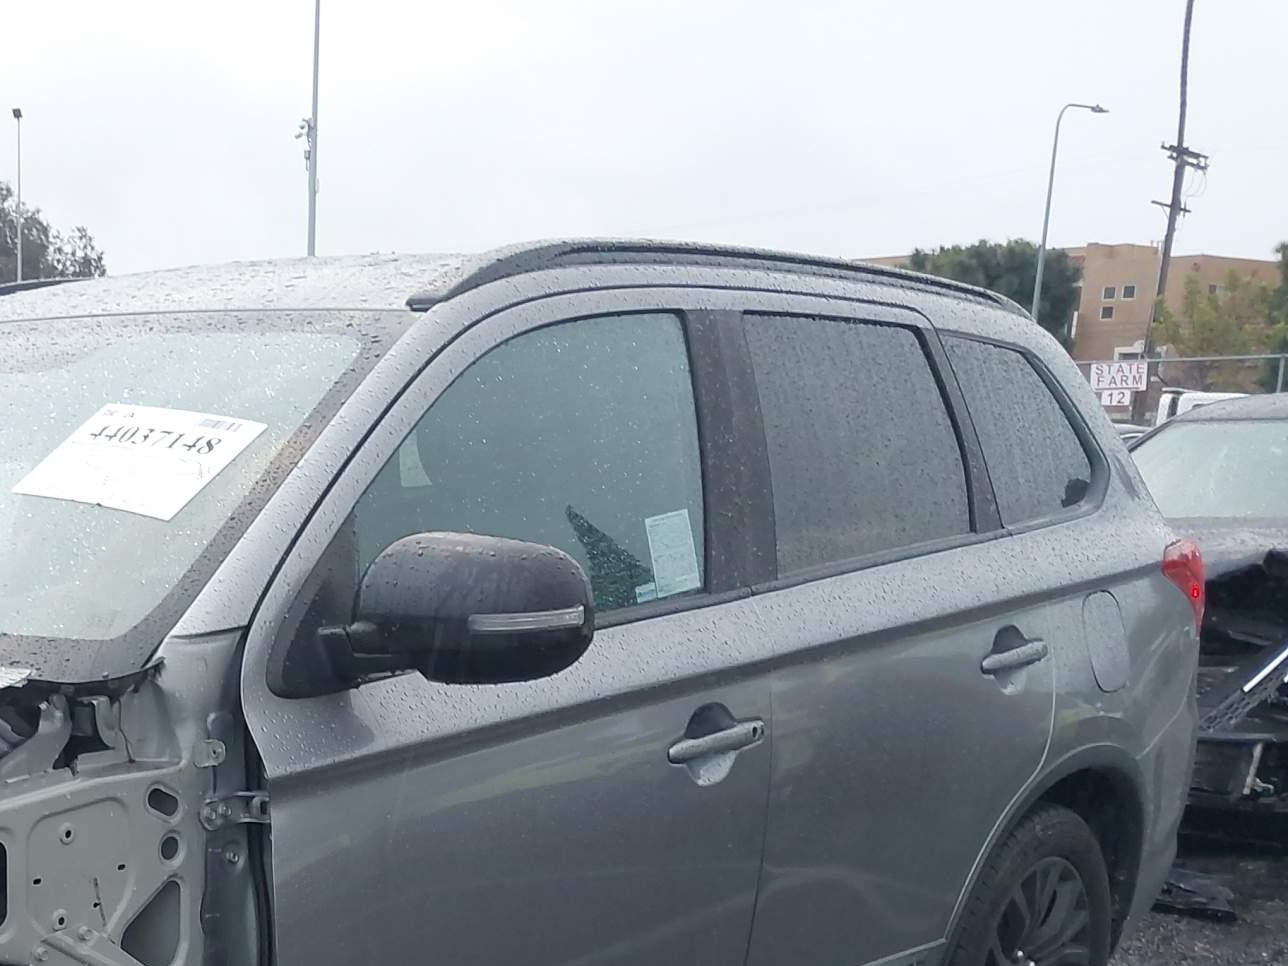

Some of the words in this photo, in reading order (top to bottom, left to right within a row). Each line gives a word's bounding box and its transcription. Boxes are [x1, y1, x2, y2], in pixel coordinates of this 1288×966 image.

[1095, 363, 1145, 375] STATE
[1097, 375, 1143, 387] FARM
[1108, 391, 1126, 405] 12
[89, 425, 223, 455] 44037148
